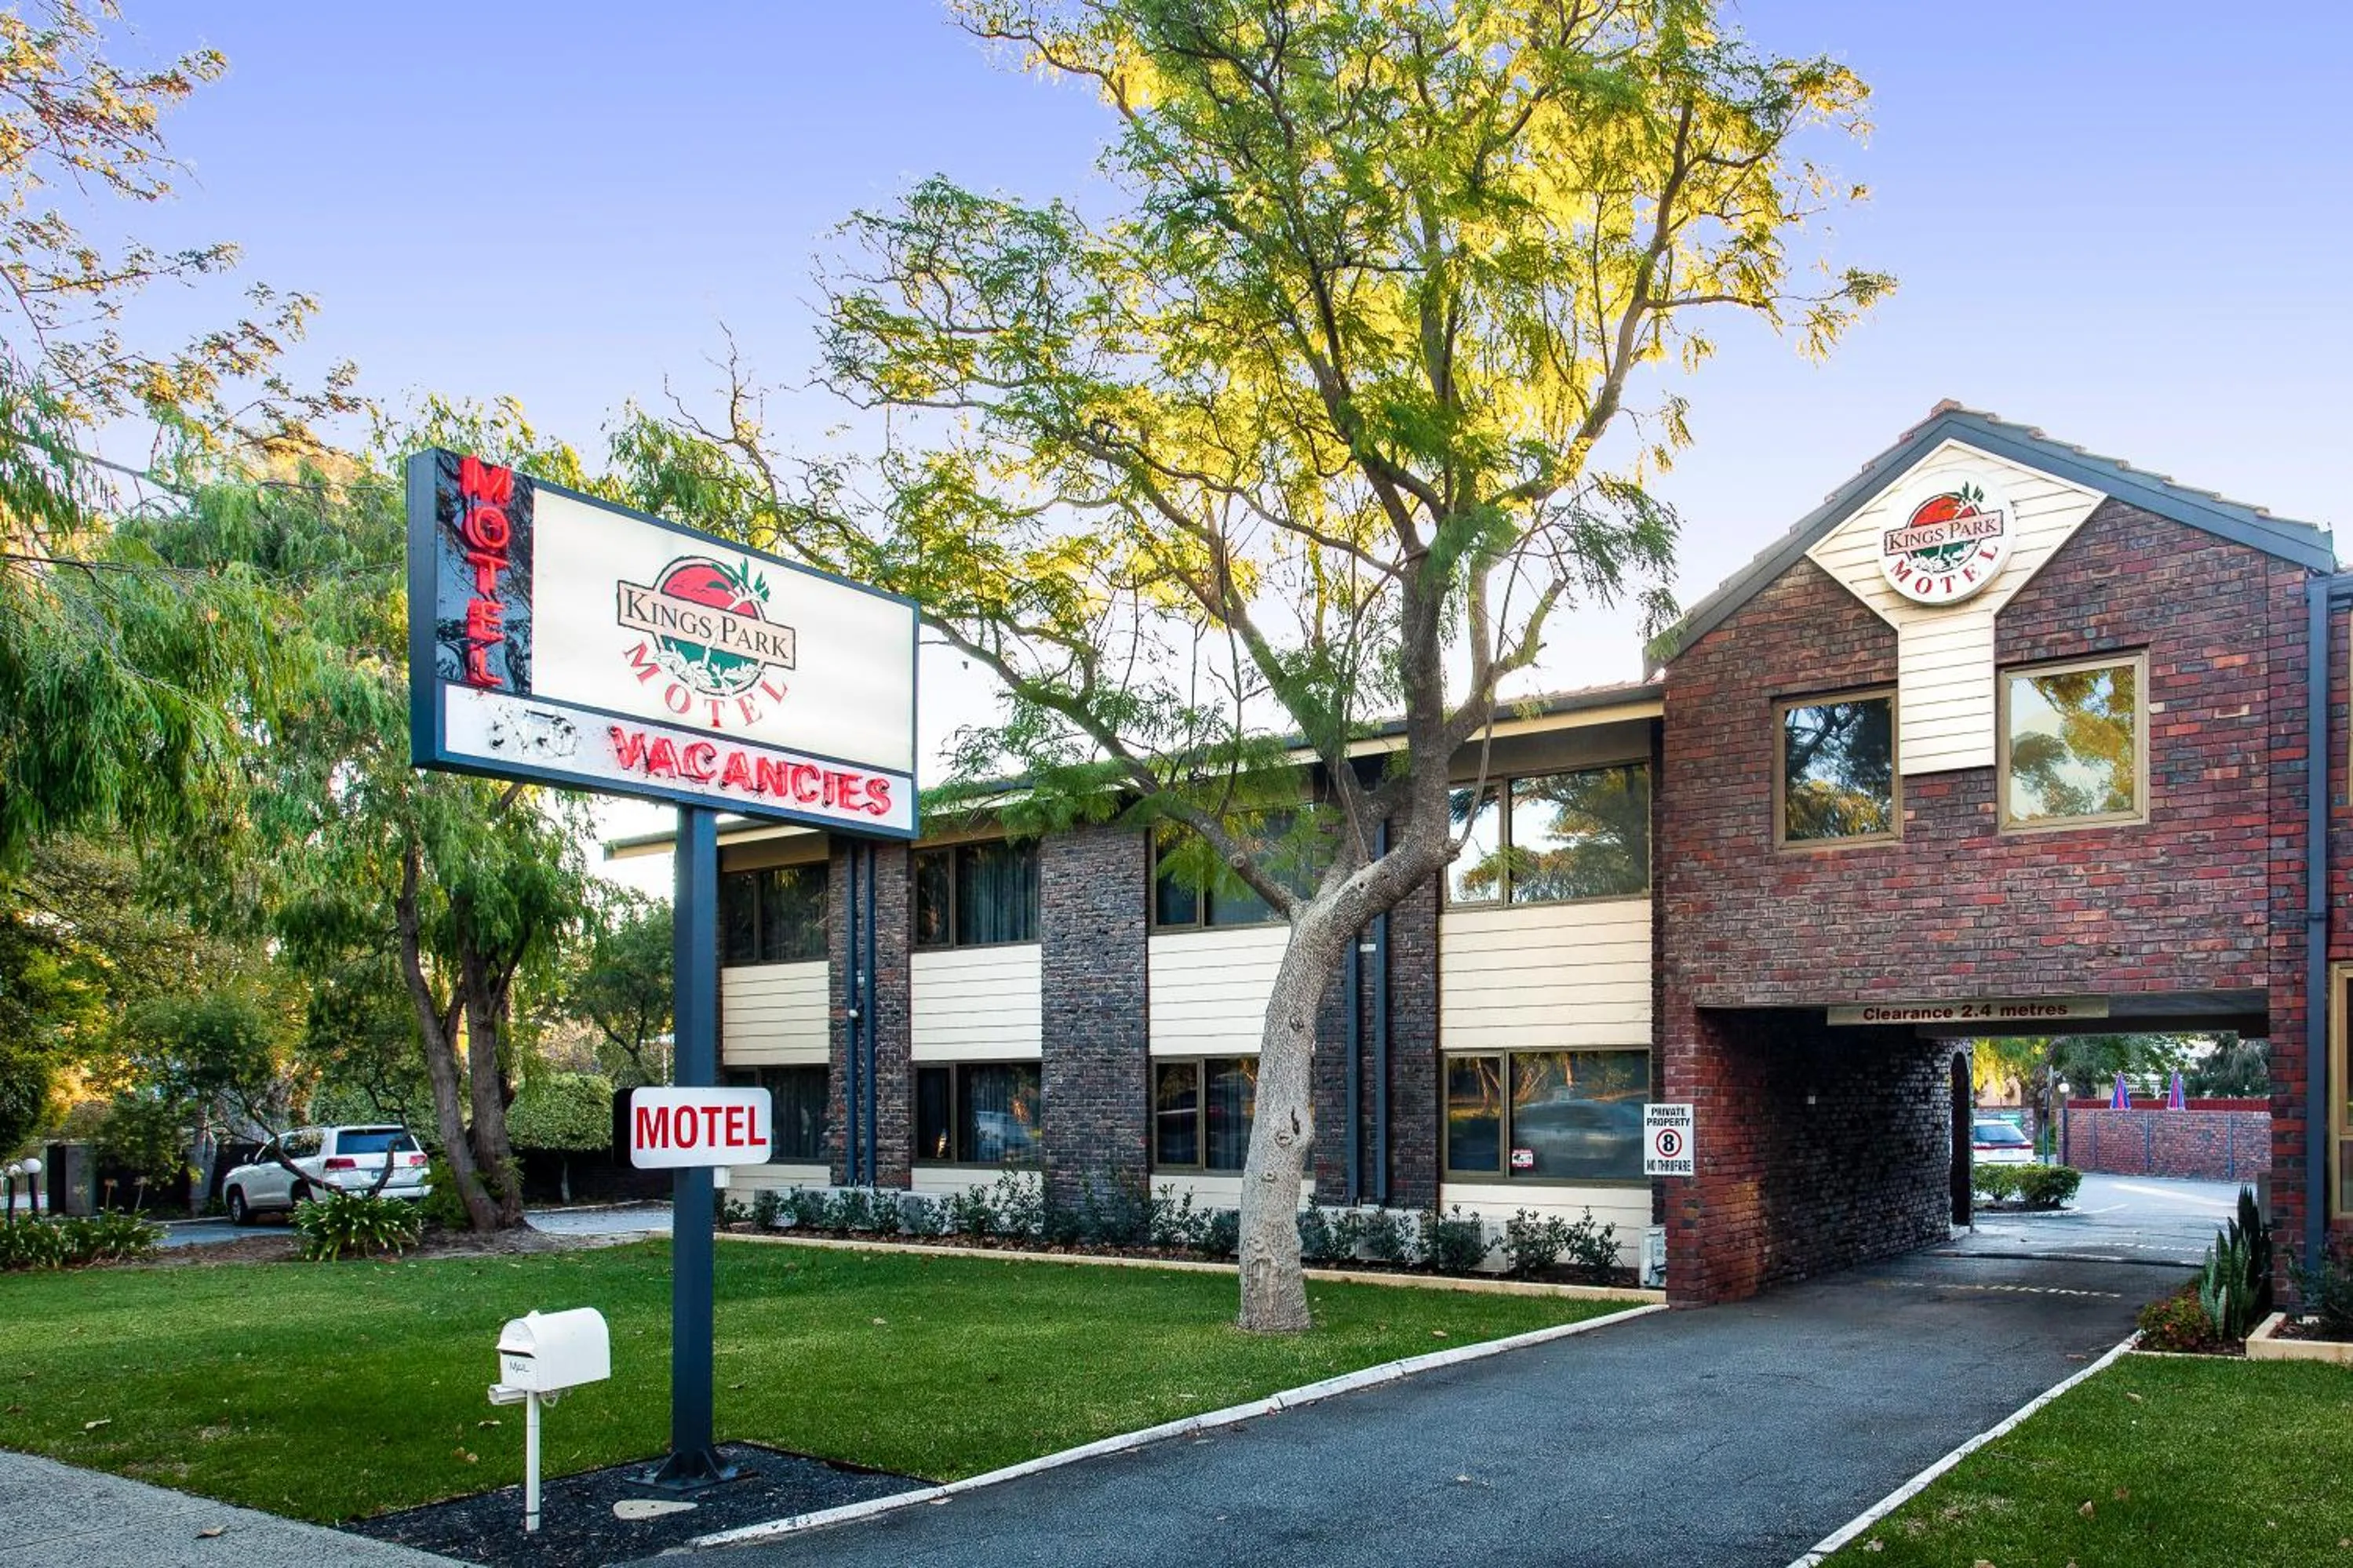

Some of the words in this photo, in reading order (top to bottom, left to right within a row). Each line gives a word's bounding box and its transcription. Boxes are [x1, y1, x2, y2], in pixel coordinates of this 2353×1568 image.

[1889, 526, 1944, 551] KINGS
[1949, 518, 1998, 540] PARK
[459, 453, 514, 687] MOTEL
[1889, 545, 1998, 595] MOTEL
[626, 588, 713, 639] KINGS
[720, 616, 789, 660] PARK
[623, 639, 789, 728] MOTEL
[609, 726, 891, 817] VACANCIES
[1863, 1007, 1954, 1020] Clearance
[1961, 1004, 1991, 1017] 2.4
[1999, 1003, 2068, 1017] metres
[636, 1104, 767, 1150] MOTEL
[1646, 1117, 1690, 1126] PROPERTY
[1651, 1107, 1686, 1116] PRIVATE
[1663, 1133, 1674, 1151] 8
